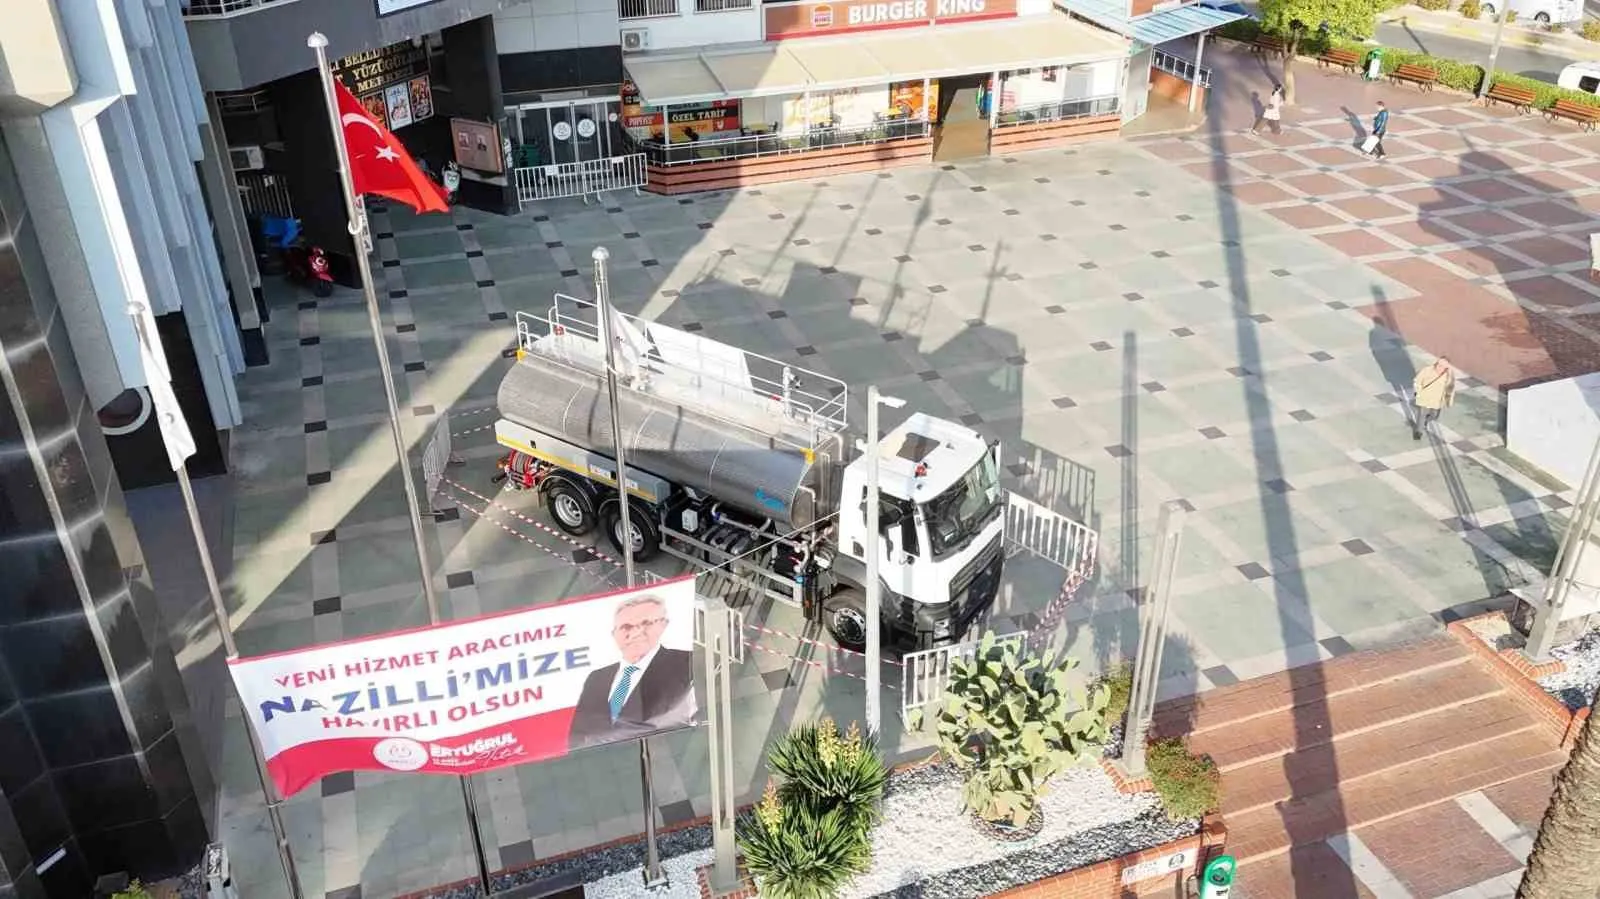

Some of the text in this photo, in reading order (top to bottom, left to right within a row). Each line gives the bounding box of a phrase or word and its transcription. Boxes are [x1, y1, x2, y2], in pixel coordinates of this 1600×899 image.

[848, 0, 928, 24] BURGER
[937, 0, 986, 16] KING
[671, 112, 695, 122] ÖZEL
[275, 624, 567, 689] YENİ HİZMET ARACIMIZ
[448, 685, 543, 721] OLSUN
[430, 732, 518, 758] ERTUĞRUL
